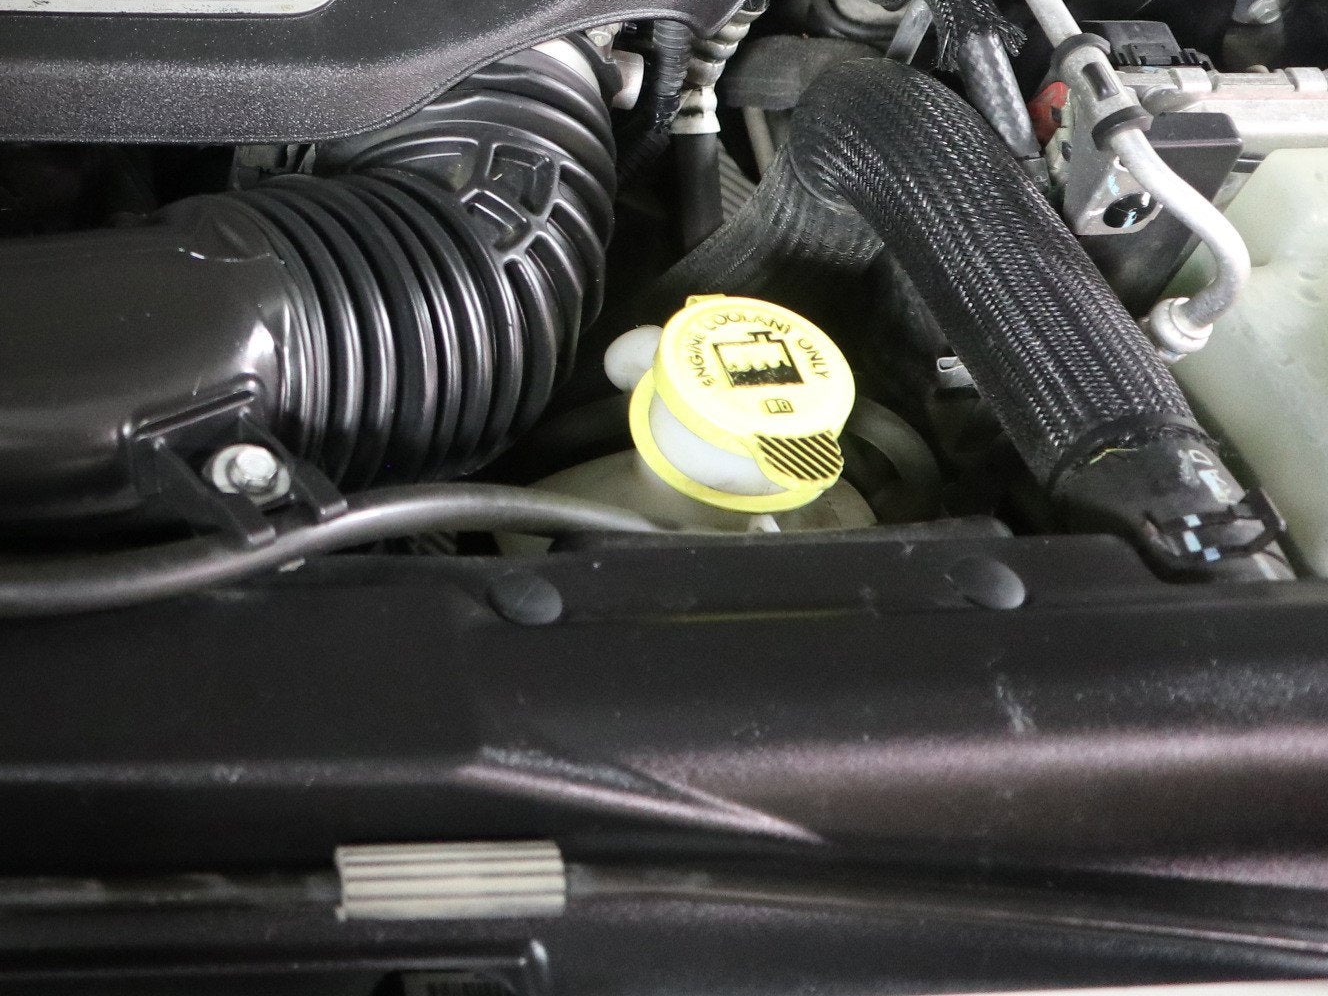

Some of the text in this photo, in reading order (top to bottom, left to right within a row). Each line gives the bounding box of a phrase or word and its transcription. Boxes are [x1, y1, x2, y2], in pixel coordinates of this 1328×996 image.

[689, 314, 830, 387] ENGINE COOLANT ONLY
